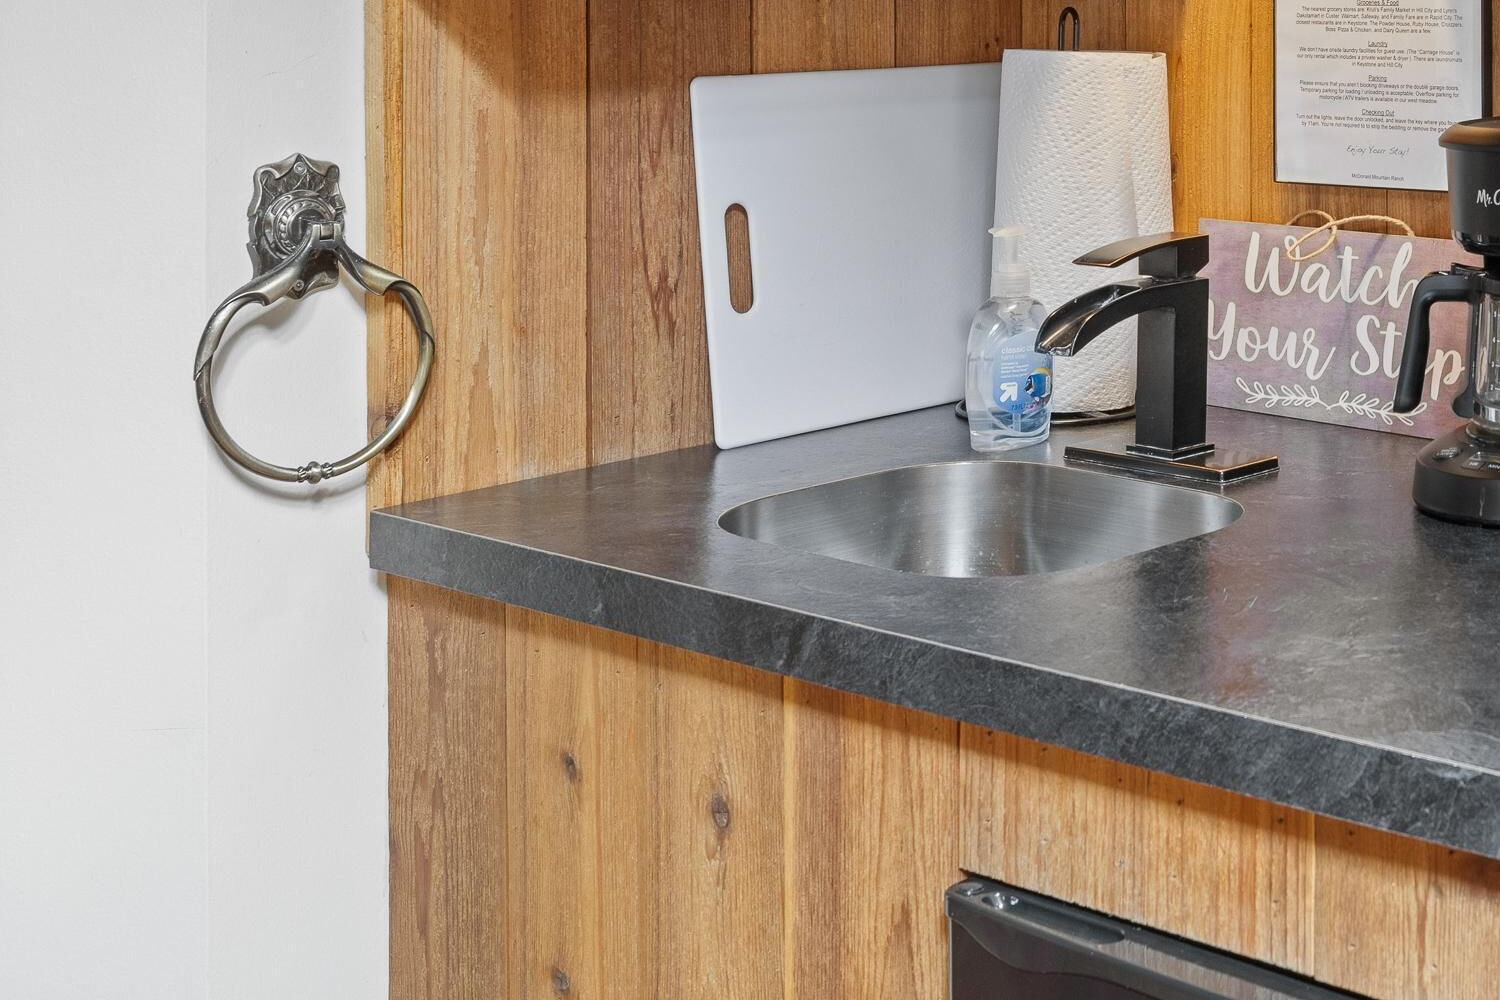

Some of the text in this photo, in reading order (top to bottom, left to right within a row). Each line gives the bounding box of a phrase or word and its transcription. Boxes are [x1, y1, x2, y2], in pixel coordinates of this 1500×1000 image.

[1368, 40, 1388, 49] Laundry
[1369, 75, 1387, 83] Parking
[1362, 109, 1384, 117] Checking
[1346, 145, 1366, 156] Enjoy
[1368, 146, 1386, 154] Your
[1476, 189, 1493, 208] Mr.
[1245, 231, 1419, 308] Watch
[1208, 299, 1465, 400] Your Stp
